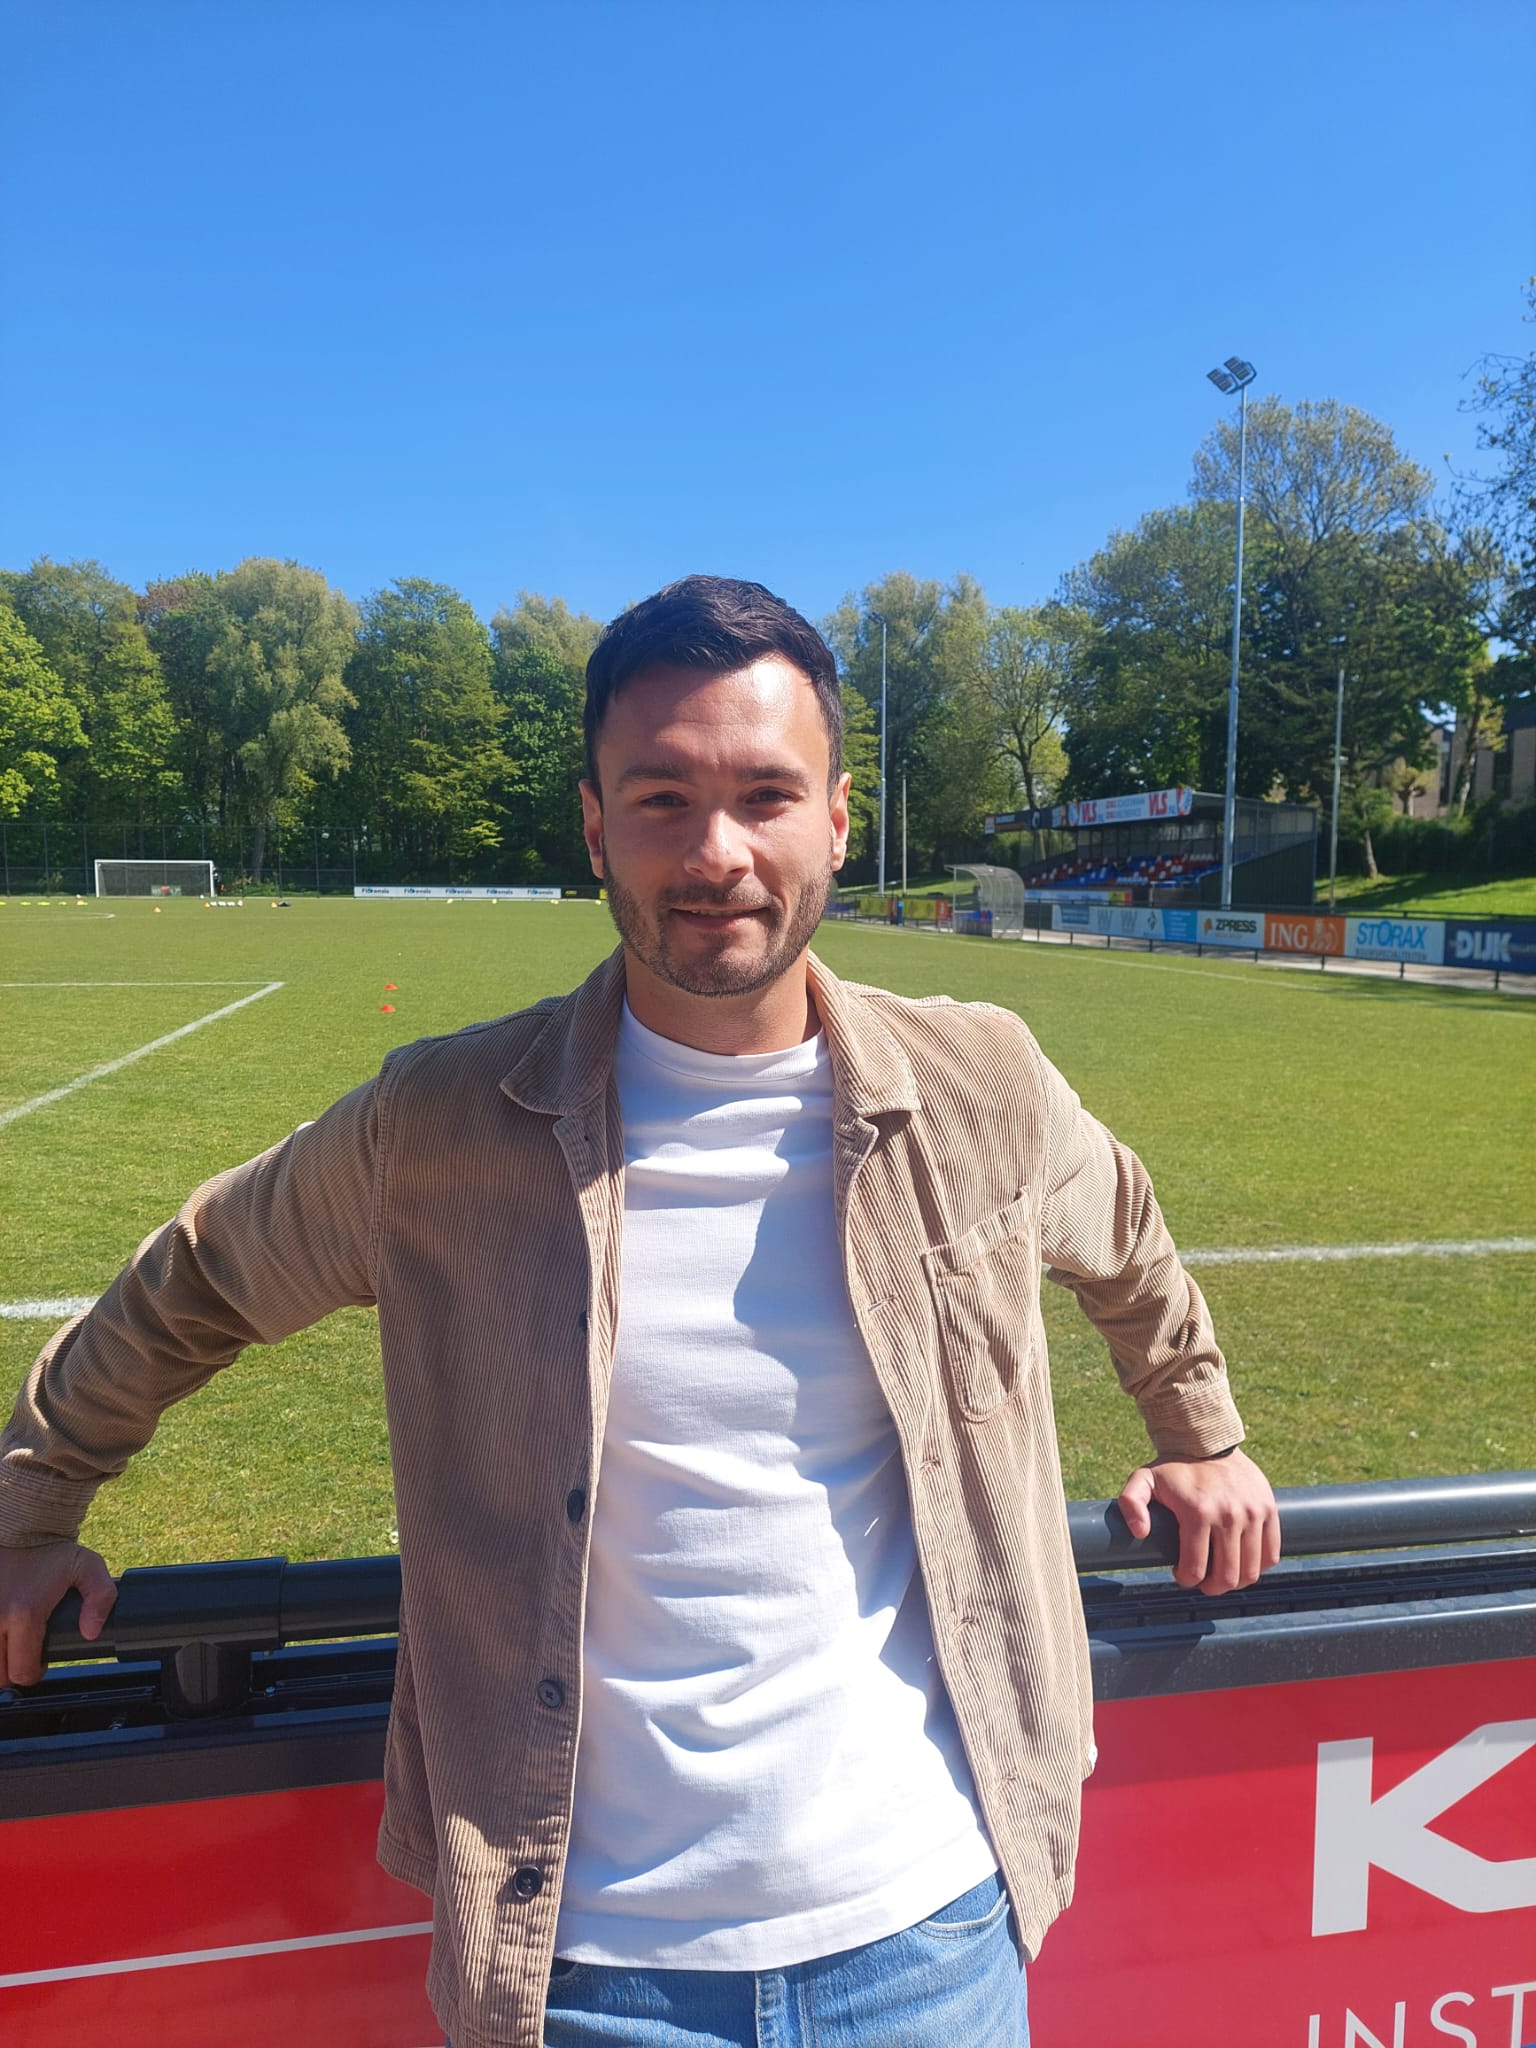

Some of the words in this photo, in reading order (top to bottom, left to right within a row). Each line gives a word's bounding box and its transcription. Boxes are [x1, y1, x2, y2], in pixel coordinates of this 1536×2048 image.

[1215, 918, 1257, 933] ZPRESS
[1270, 923, 1308, 949] ING
[1357, 919, 1428, 949] STORAX
